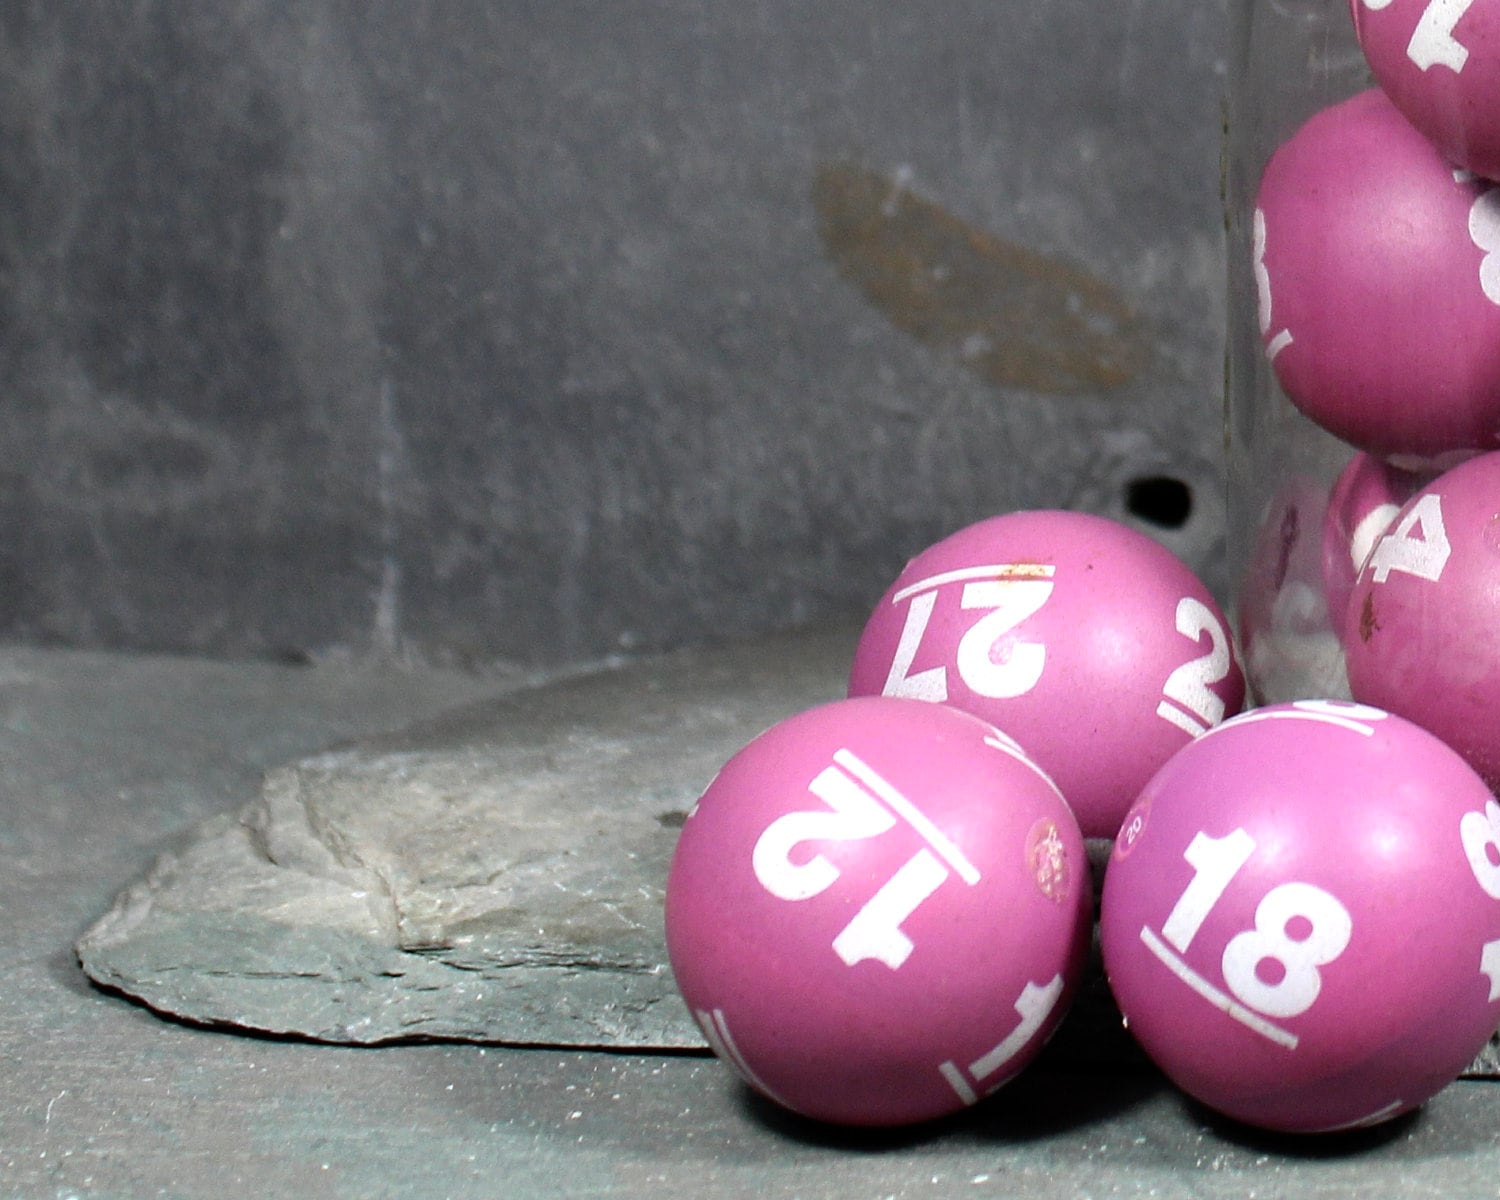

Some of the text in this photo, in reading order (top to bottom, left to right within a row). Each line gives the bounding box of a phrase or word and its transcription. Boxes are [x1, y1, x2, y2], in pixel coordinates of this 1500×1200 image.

[1368, 493, 1451, 584] 4
[881, 581, 1055, 703] 27
[751, 765, 949, 971] 12
[1160, 827, 1353, 1018] 18
